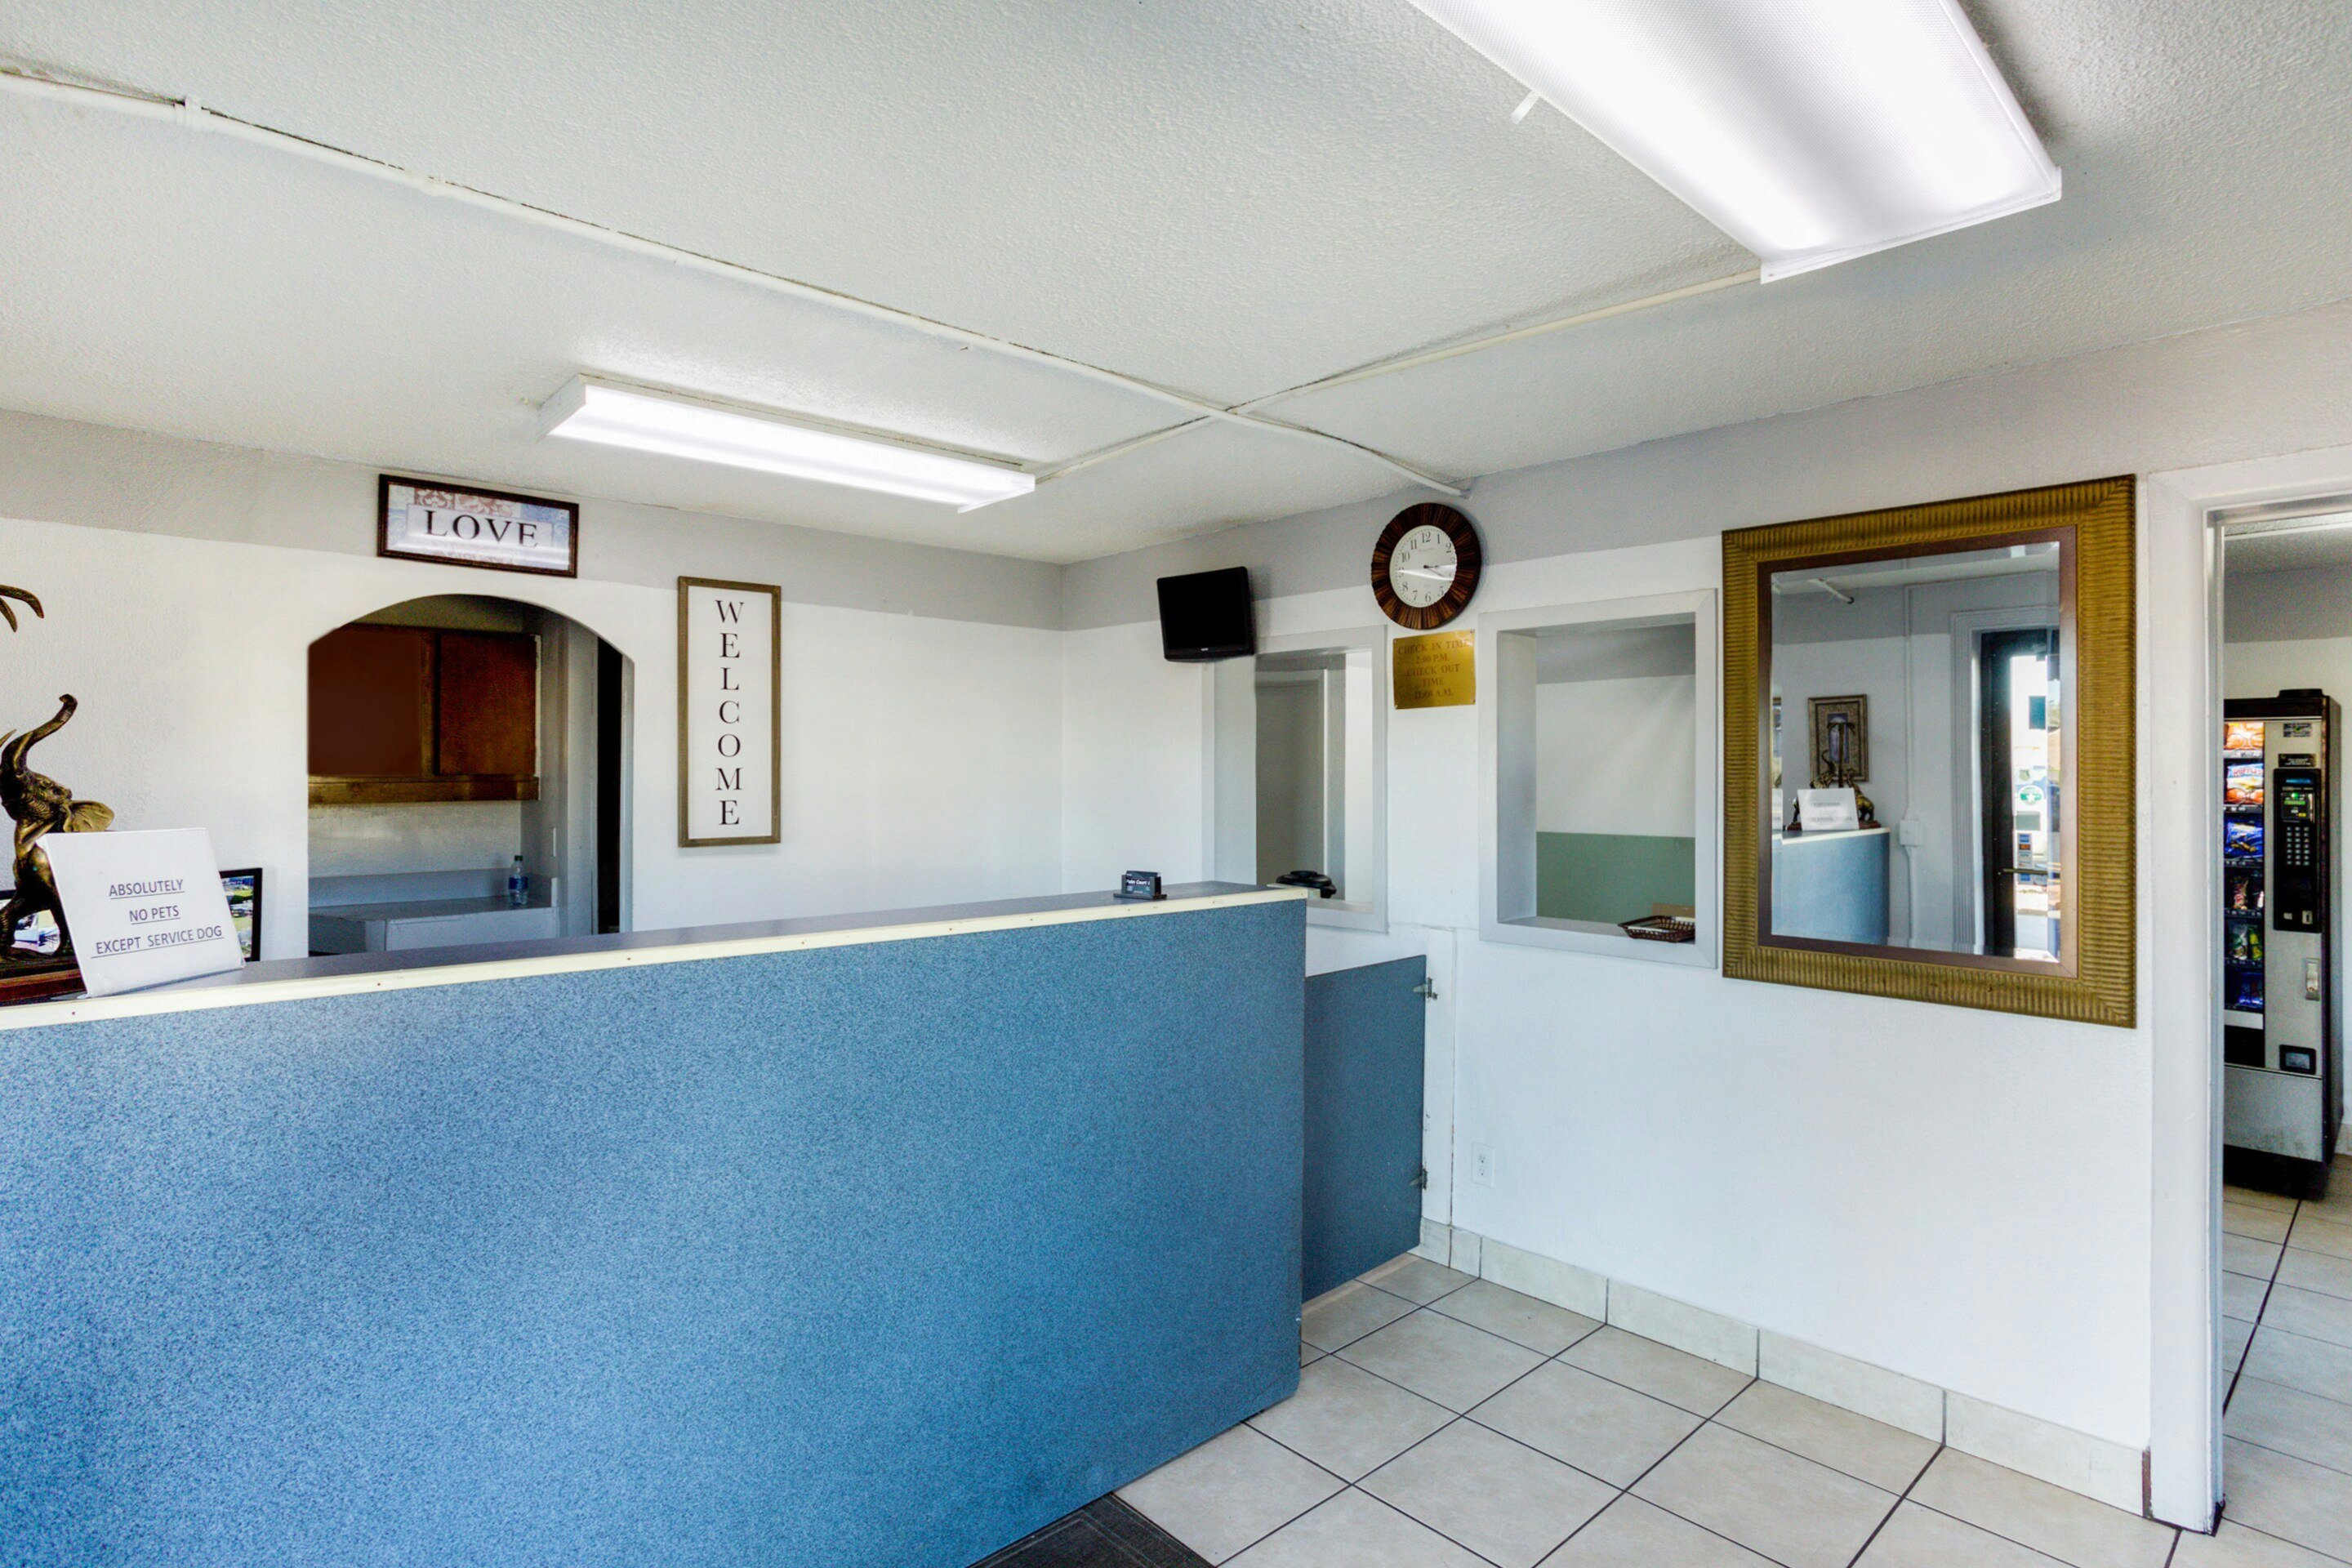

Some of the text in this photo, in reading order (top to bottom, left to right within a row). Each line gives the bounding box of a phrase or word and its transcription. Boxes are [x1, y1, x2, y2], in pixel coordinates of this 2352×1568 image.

[424, 510, 538, 547] LOVE
[1421, 532, 1431, 543] 12
[1437, 533, 1441, 544] 1
[1410, 539, 1417, 550] 11
[1446, 542, 1452, 553] 2
[1401, 551, 1410, 562] 10
[1401, 581, 1409, 592] 8
[1437, 586, 1444, 597] 5
[1412, 590, 1419, 601] 7
[1424, 591, 1432, 603] 6
[1398, 639, 1469, 654] CHECK IN TIME
[1405, 664, 1460, 676] CHECK OUT
[1423, 678, 1445, 687] TIME
[715, 599, 745, 826] WELCOME
[109, 879, 184, 897] ABSOLUTELY
[129, 906, 179, 922] NO PETS
[96, 925, 222, 955] EXCEPT SERVICE DOG
